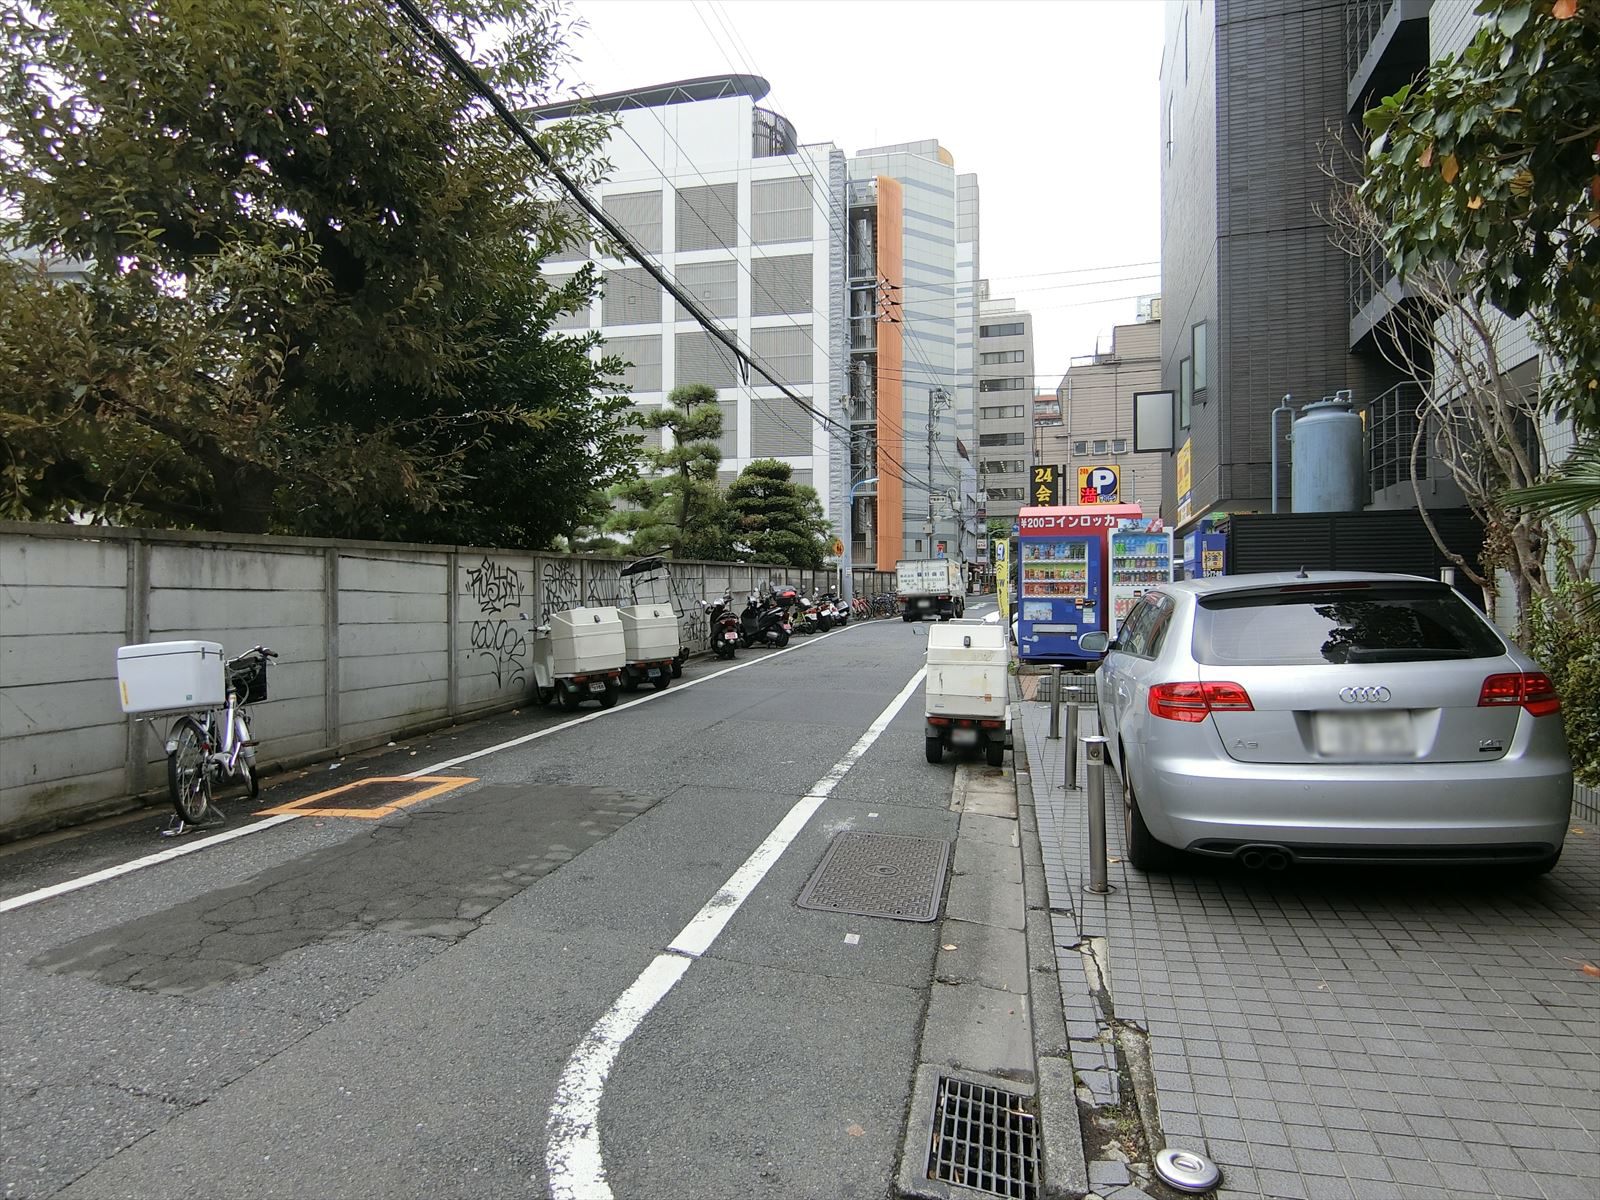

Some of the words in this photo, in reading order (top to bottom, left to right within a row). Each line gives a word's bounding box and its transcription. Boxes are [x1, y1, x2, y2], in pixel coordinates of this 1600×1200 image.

[1092, 469, 1115, 495] P
[1080, 487, 1097, 503] 満
[1232, 738, 1259, 750] A3
